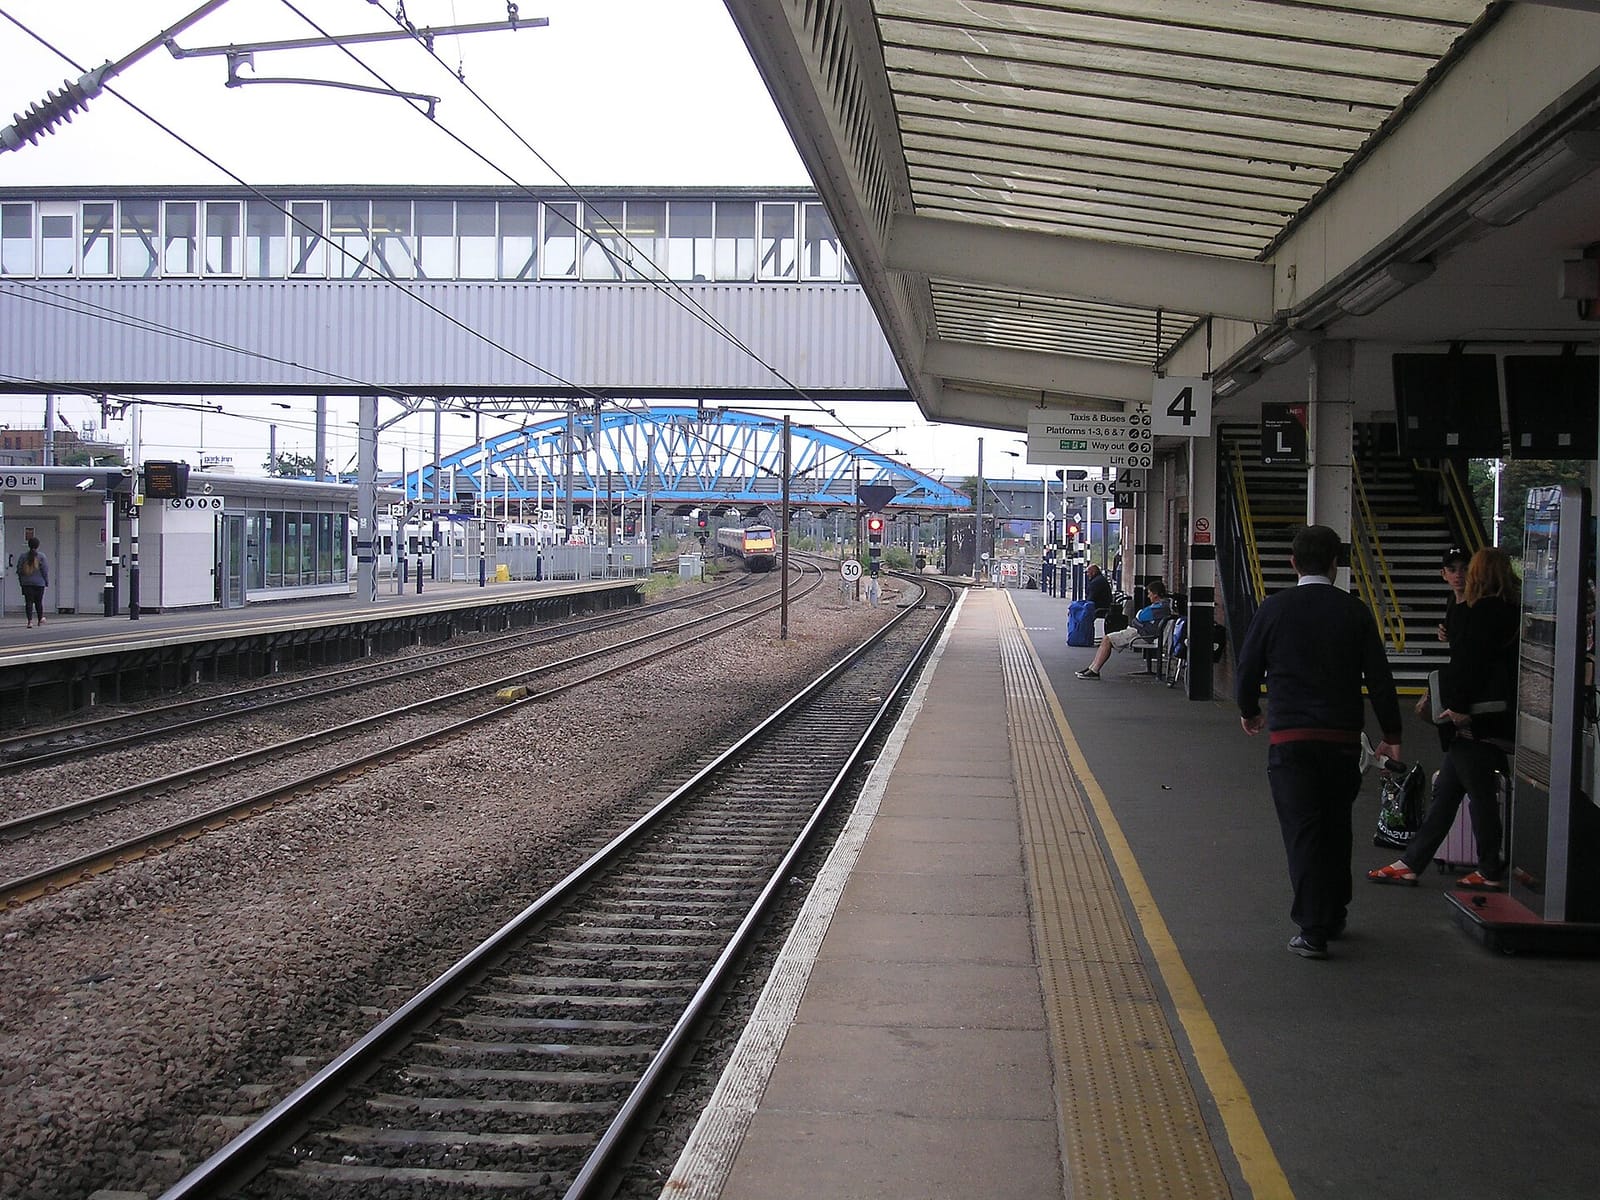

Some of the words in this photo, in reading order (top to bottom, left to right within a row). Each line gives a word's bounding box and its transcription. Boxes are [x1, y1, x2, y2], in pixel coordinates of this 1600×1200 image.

[1166, 386, 1197, 426] 4
[1070, 413, 1090, 422] Taxis
[1092, 414, 1098, 422] &
[1100, 414, 1126, 422] Buses
[1046, 426, 1086, 434] Platforms
[1088, 428, 1103, 436] 1-3,
[1091, 442, 1110, 450] Way
[1276, 431, 1292, 453] L
[1110, 456, 1124, 464] Lift
[22, 476, 37, 486] Lift
[1119, 468, 1141, 488] 4a
[1072, 483, 1089, 492] Lift
[1119, 493, 1129, 504] M
[129, 506, 138, 515] 4
[844, 564, 859, 576] 30
